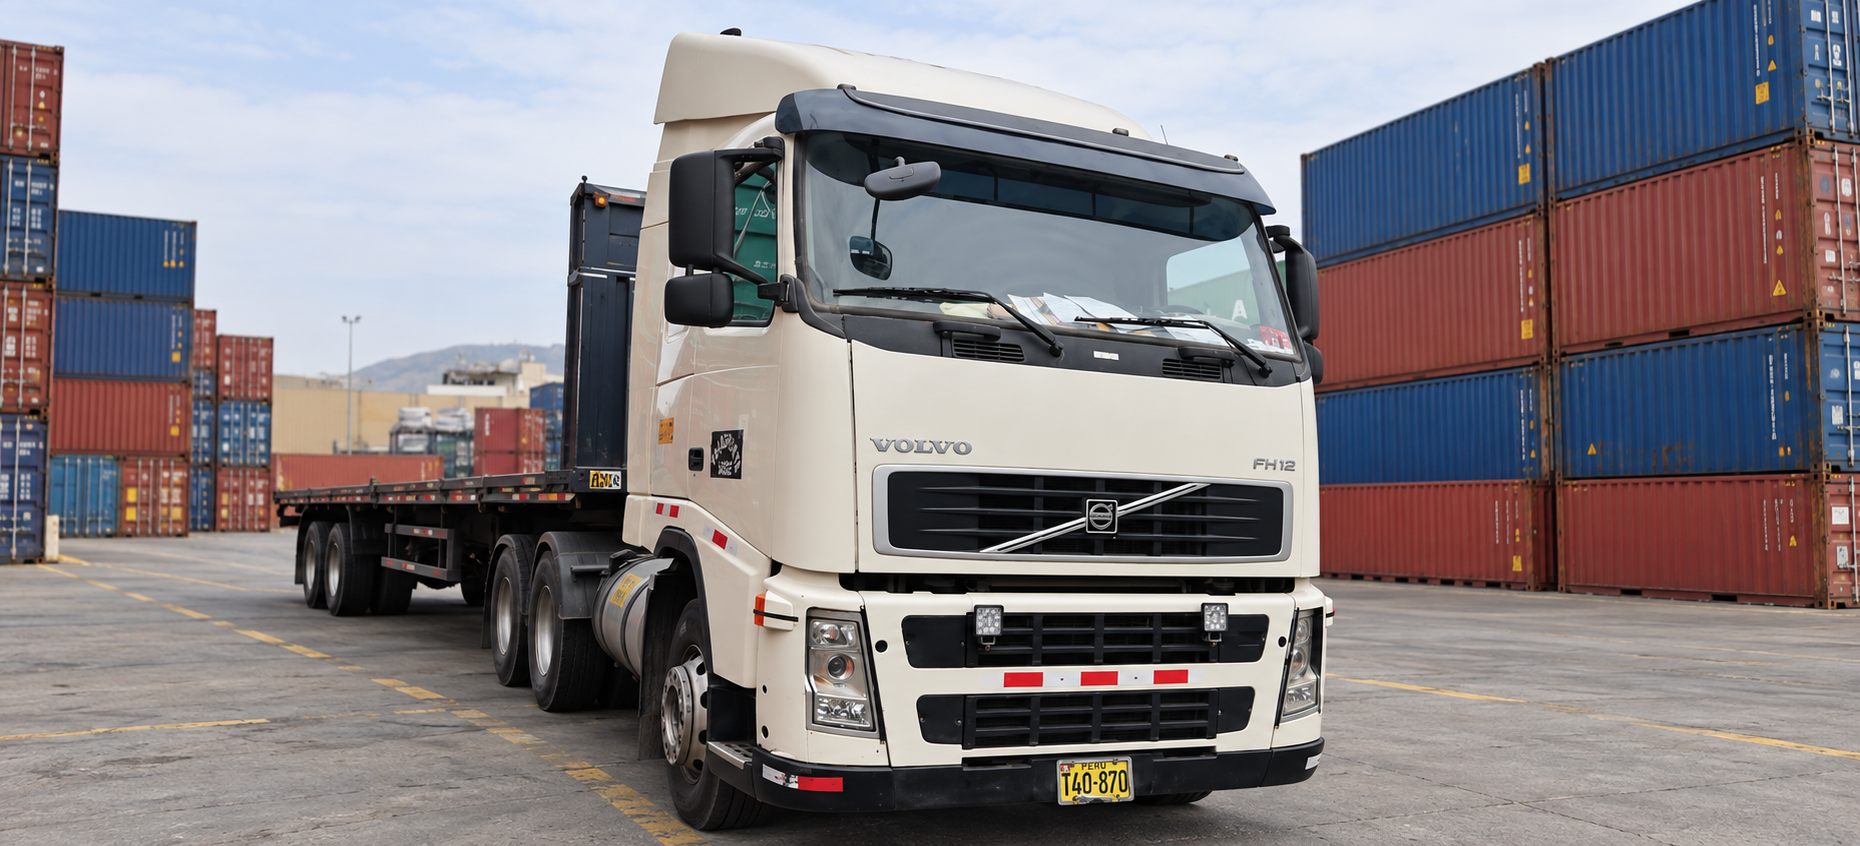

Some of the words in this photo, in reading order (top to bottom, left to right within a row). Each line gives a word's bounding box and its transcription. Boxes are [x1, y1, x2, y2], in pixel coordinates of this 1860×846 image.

[869, 437, 972, 455] VOLVO
[1081, 762, 1107, 770] PERU
[1061, 769, 1128, 796] T40-870
